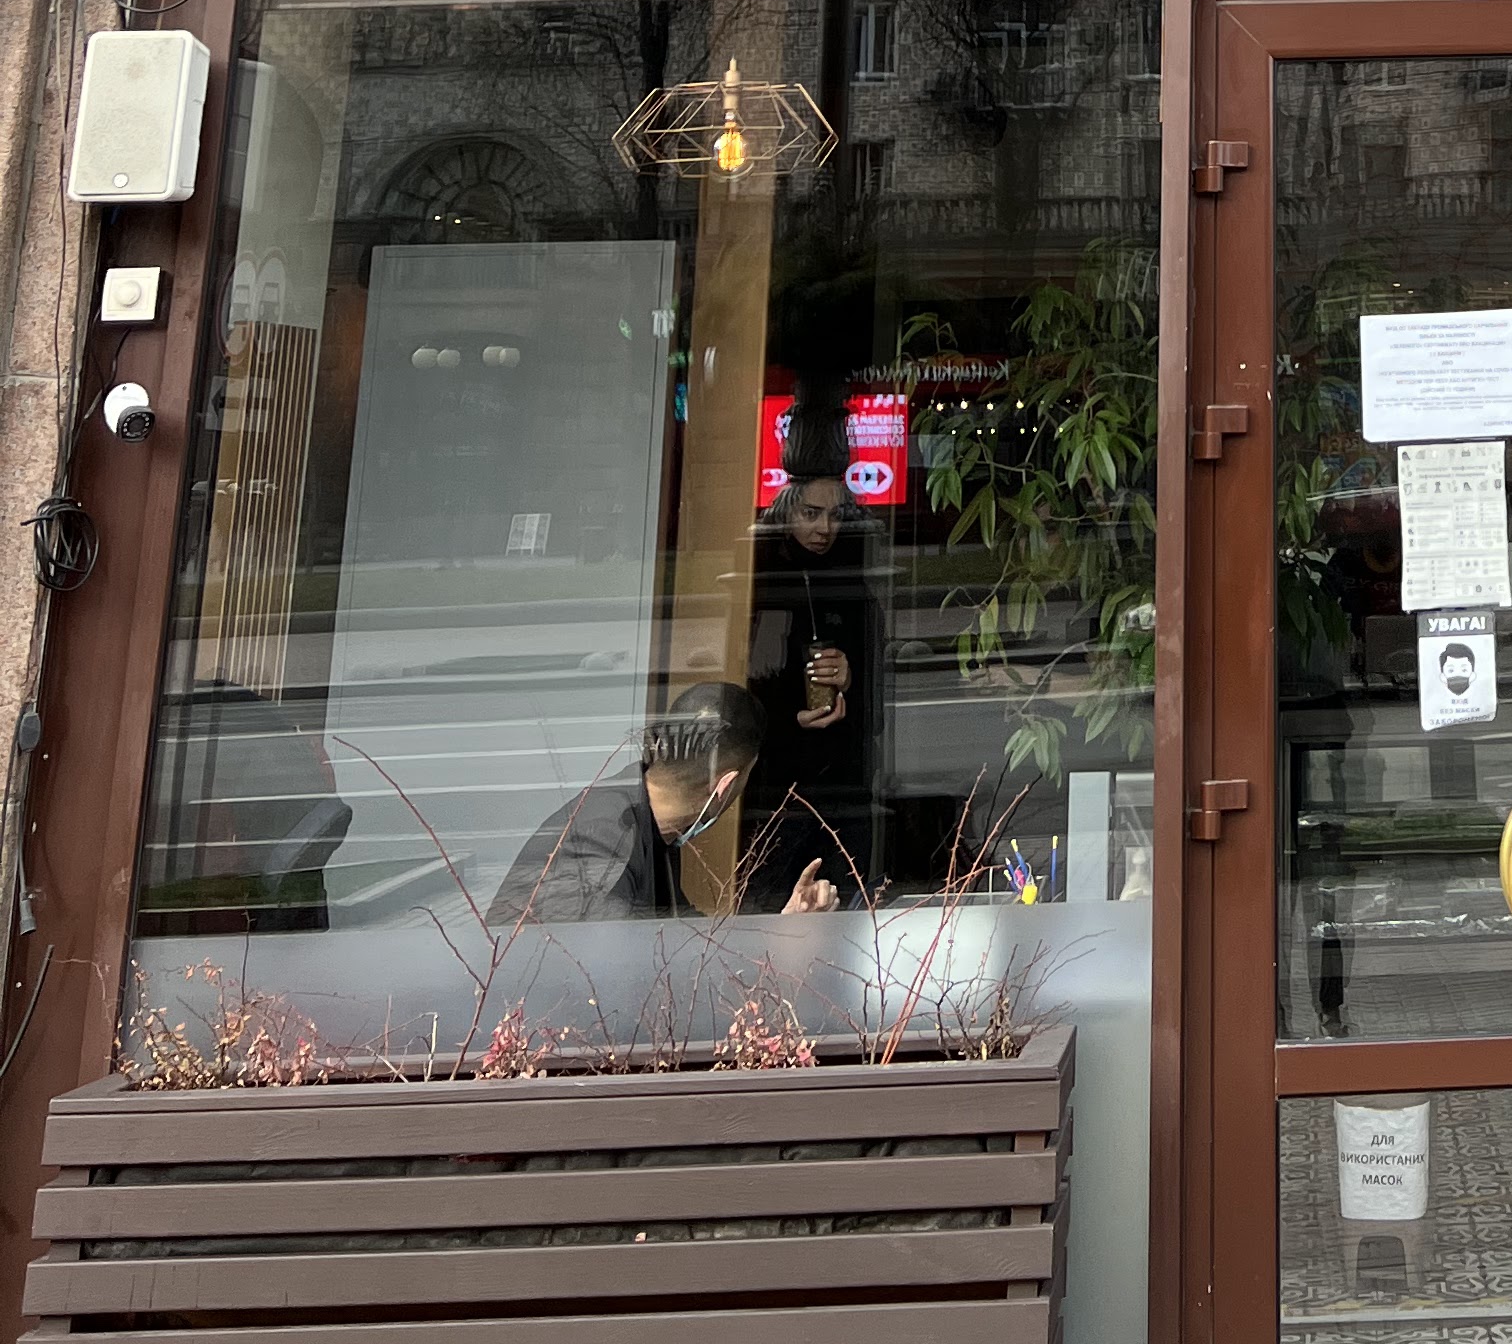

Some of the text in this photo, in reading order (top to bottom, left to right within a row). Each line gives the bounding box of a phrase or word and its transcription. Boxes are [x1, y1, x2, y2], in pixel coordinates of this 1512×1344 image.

[1427, 616, 1486, 632] УВАГА!
[1370, 1134, 1395, 1148] ДЛЯ
[1340, 1153, 1425, 1166] ВИКОРИСТАНИХ
[1361, 1174, 1403, 1186] МАСОК
